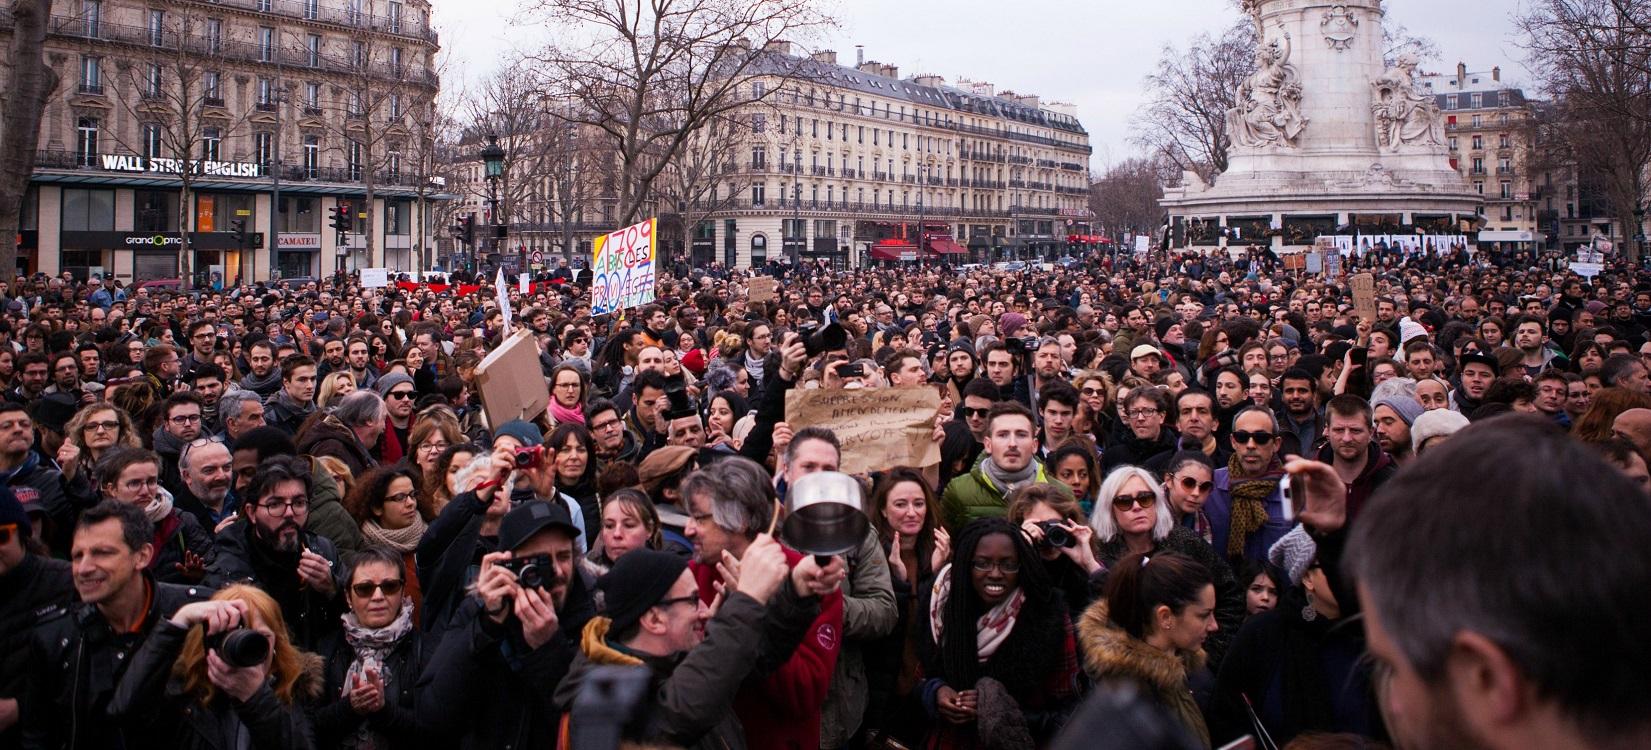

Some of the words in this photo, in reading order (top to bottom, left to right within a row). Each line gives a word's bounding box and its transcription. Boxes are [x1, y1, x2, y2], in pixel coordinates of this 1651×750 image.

[102, 154, 145, 171] WALL
[149, 157, 199, 174] STRET
[203, 160, 258, 177] ENGLISH
[629, 245, 649, 264] LES
